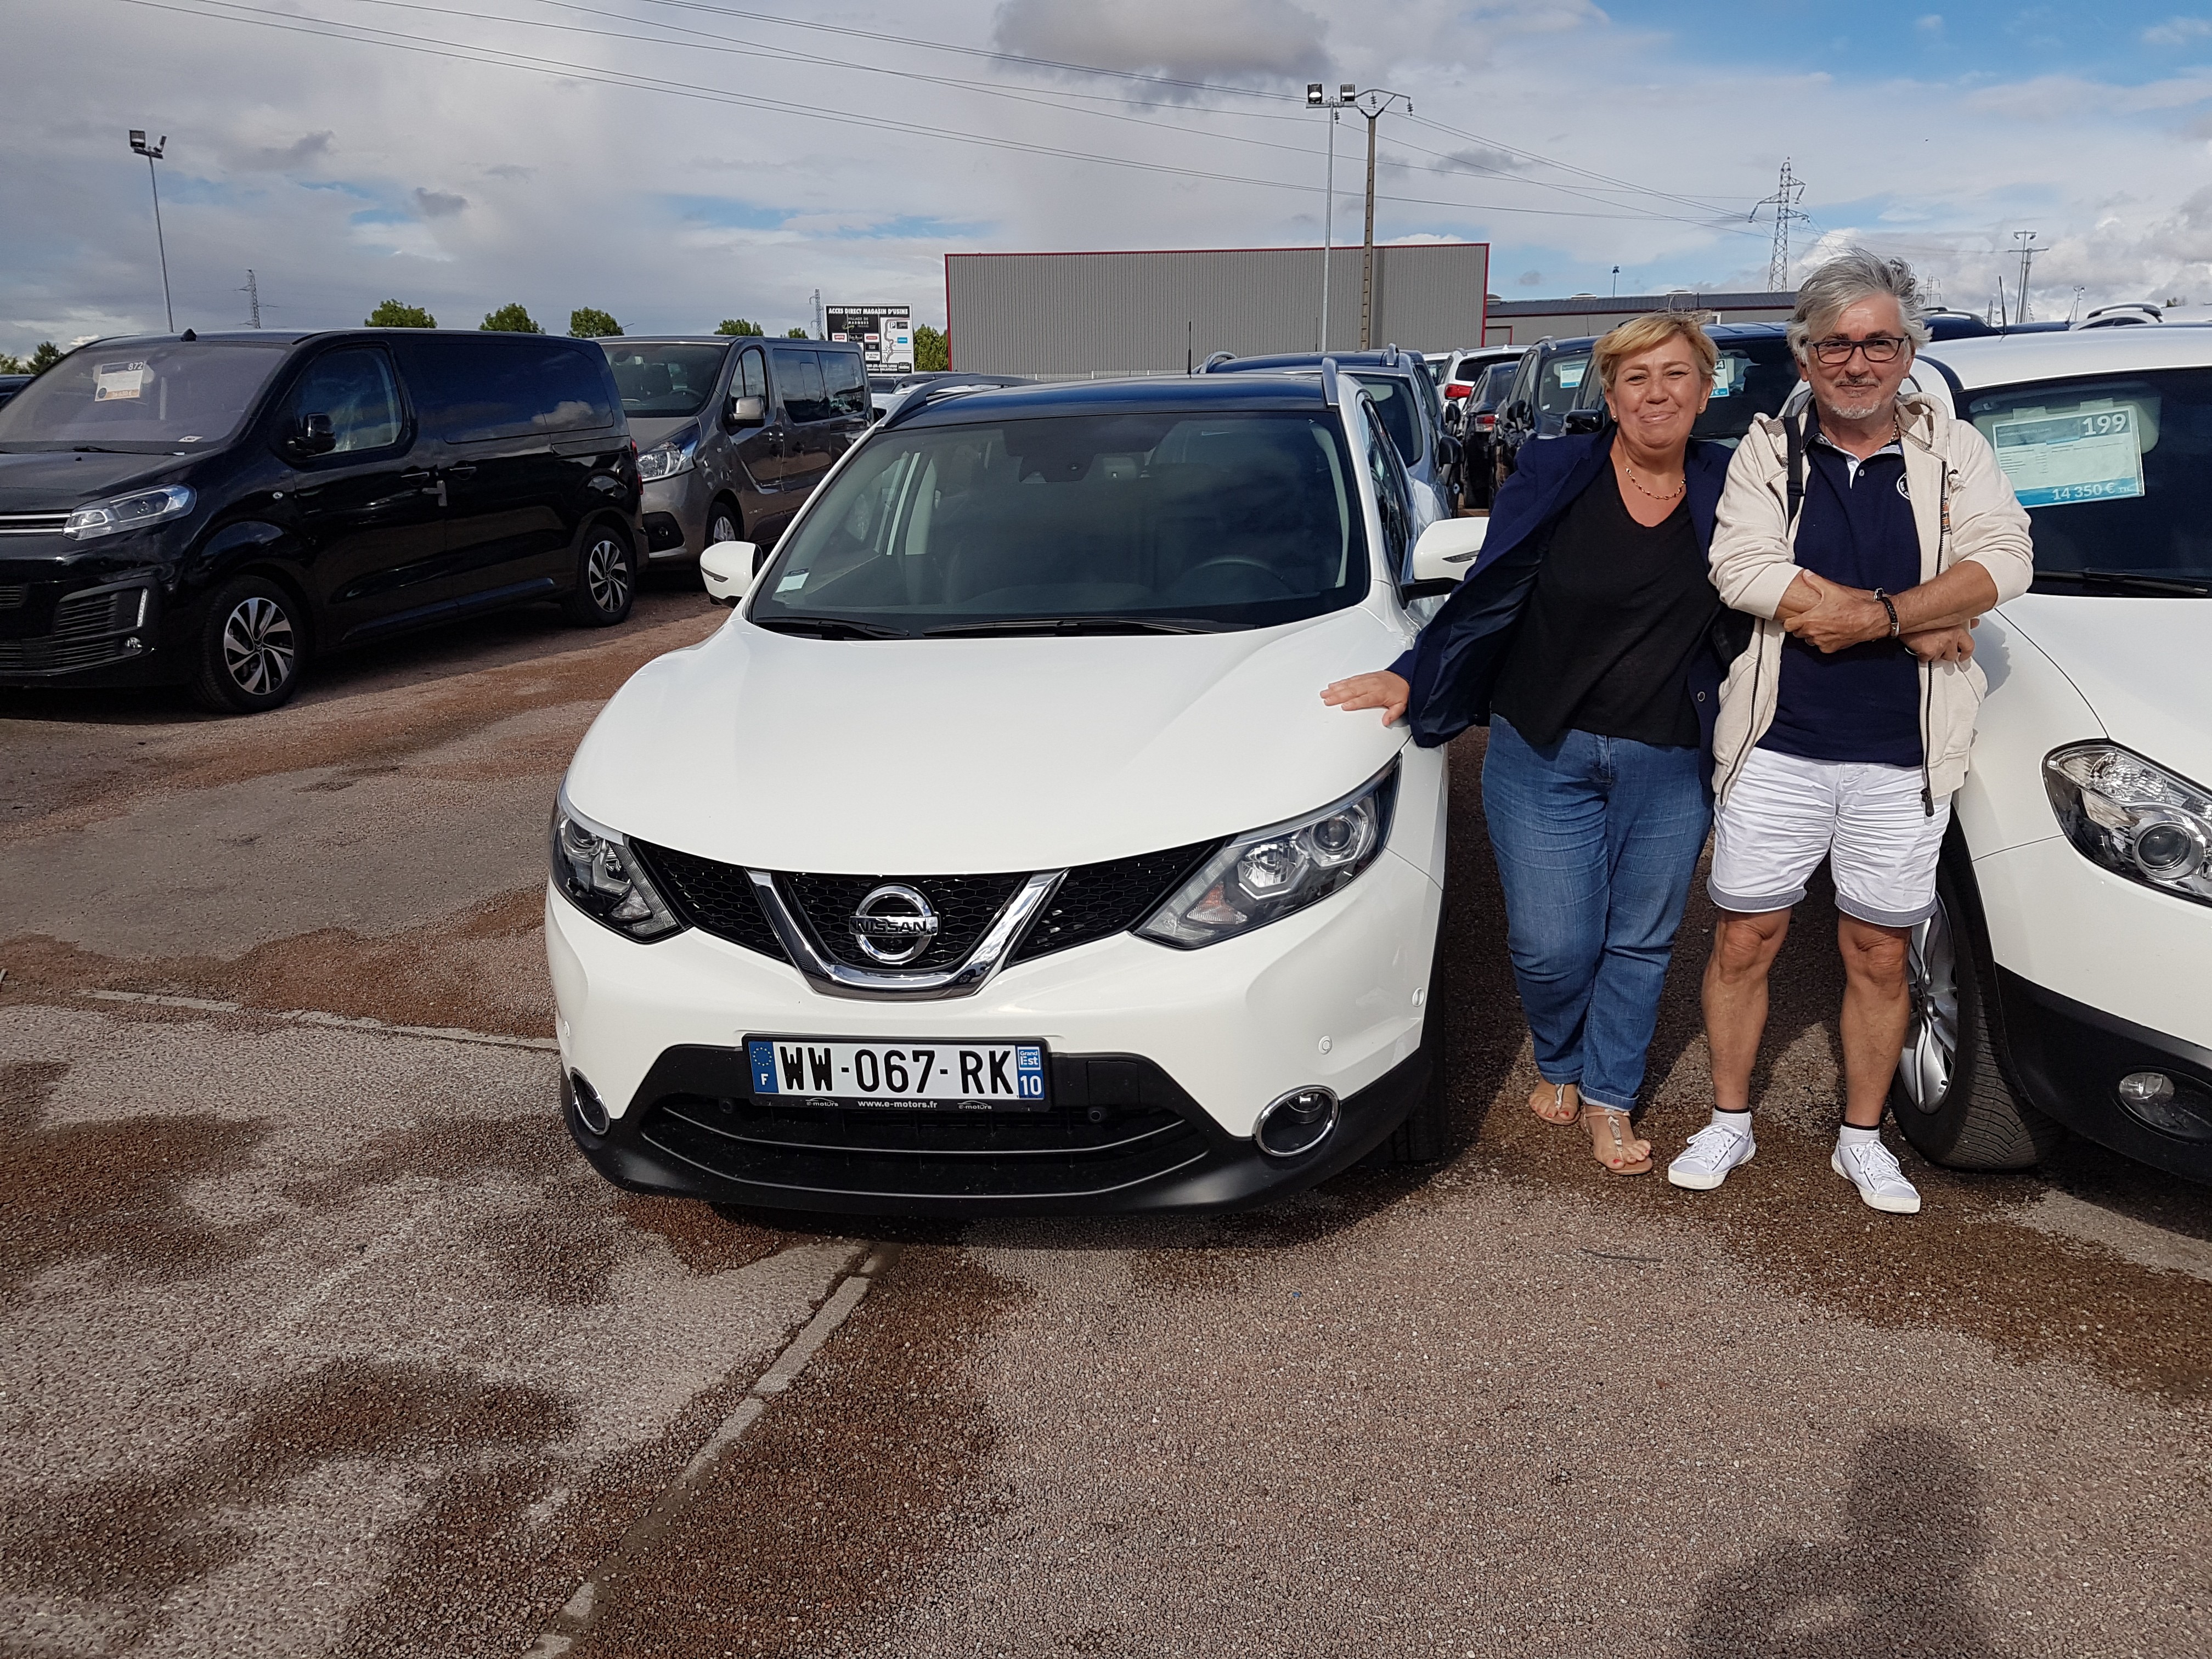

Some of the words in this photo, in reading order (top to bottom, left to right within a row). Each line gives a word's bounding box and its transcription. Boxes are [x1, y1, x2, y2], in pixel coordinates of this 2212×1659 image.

[128, 362, 143, 370] 872
[2082, 414, 2126, 436] 199
[2052, 487, 2070, 500] 14
[2074, 484, 2102, 498] 350
[2106, 482, 2115, 494] €
[856, 920, 927, 933] NISSAN
[1020, 1056, 1039, 1065] Est
[761, 1073, 769, 1085] F
[1020, 1075, 1042, 1096] 10
[857, 1101, 938, 1109] www.e-motors.fr
